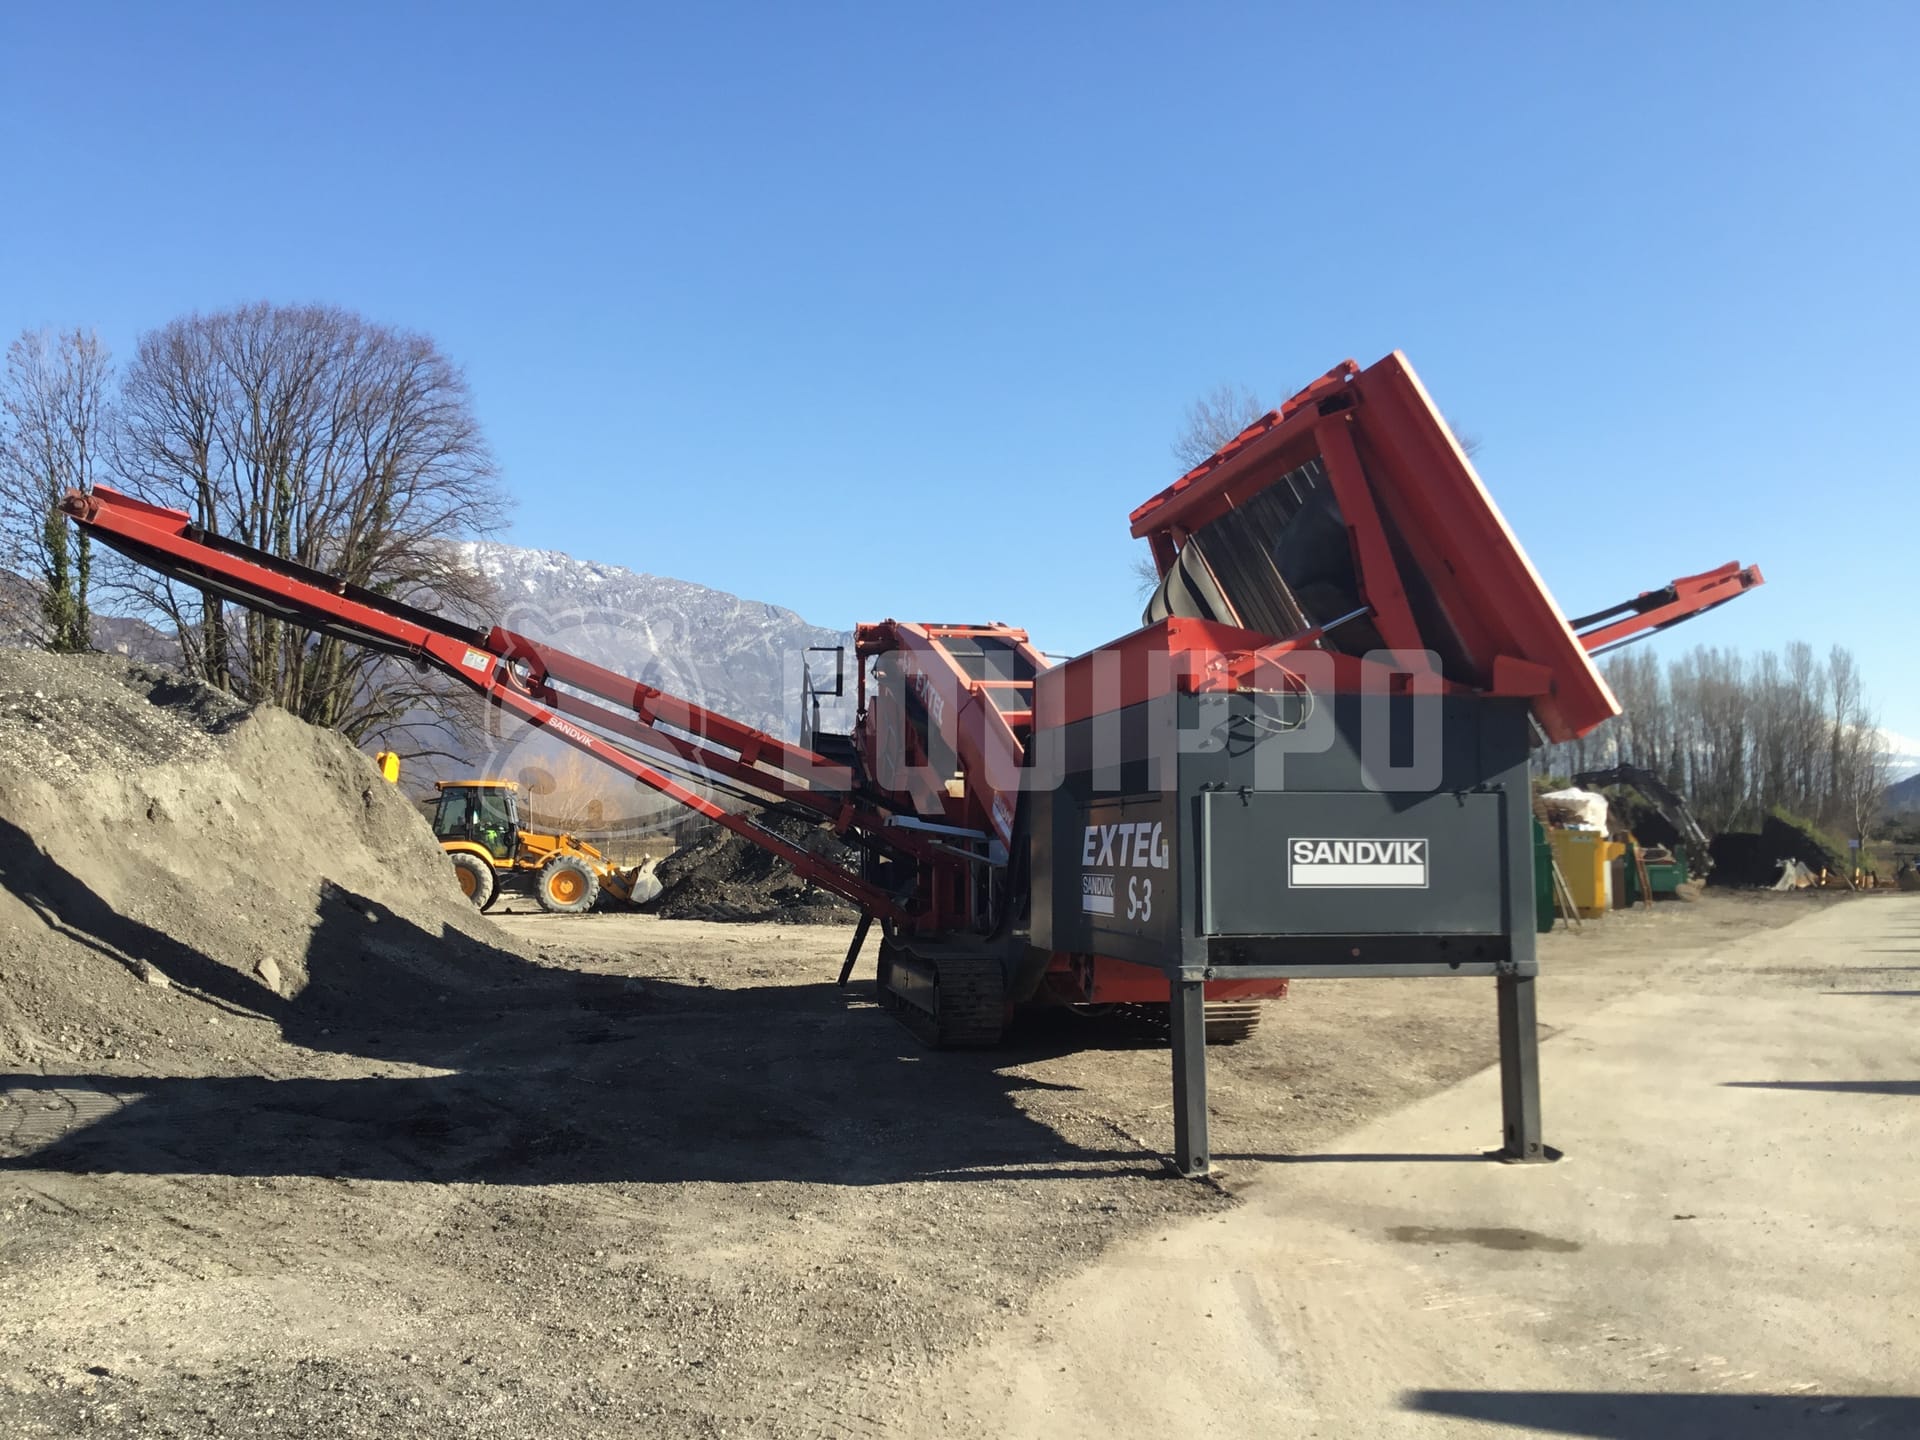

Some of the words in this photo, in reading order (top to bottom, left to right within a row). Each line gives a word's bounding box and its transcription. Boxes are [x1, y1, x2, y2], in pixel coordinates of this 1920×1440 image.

[549, 717, 593, 747] SANDVIK
[1293, 841, 1424, 864] SANDVIK
[1082, 876, 1114, 896] SANDVIK
[1127, 875, 1152, 922] S-3
